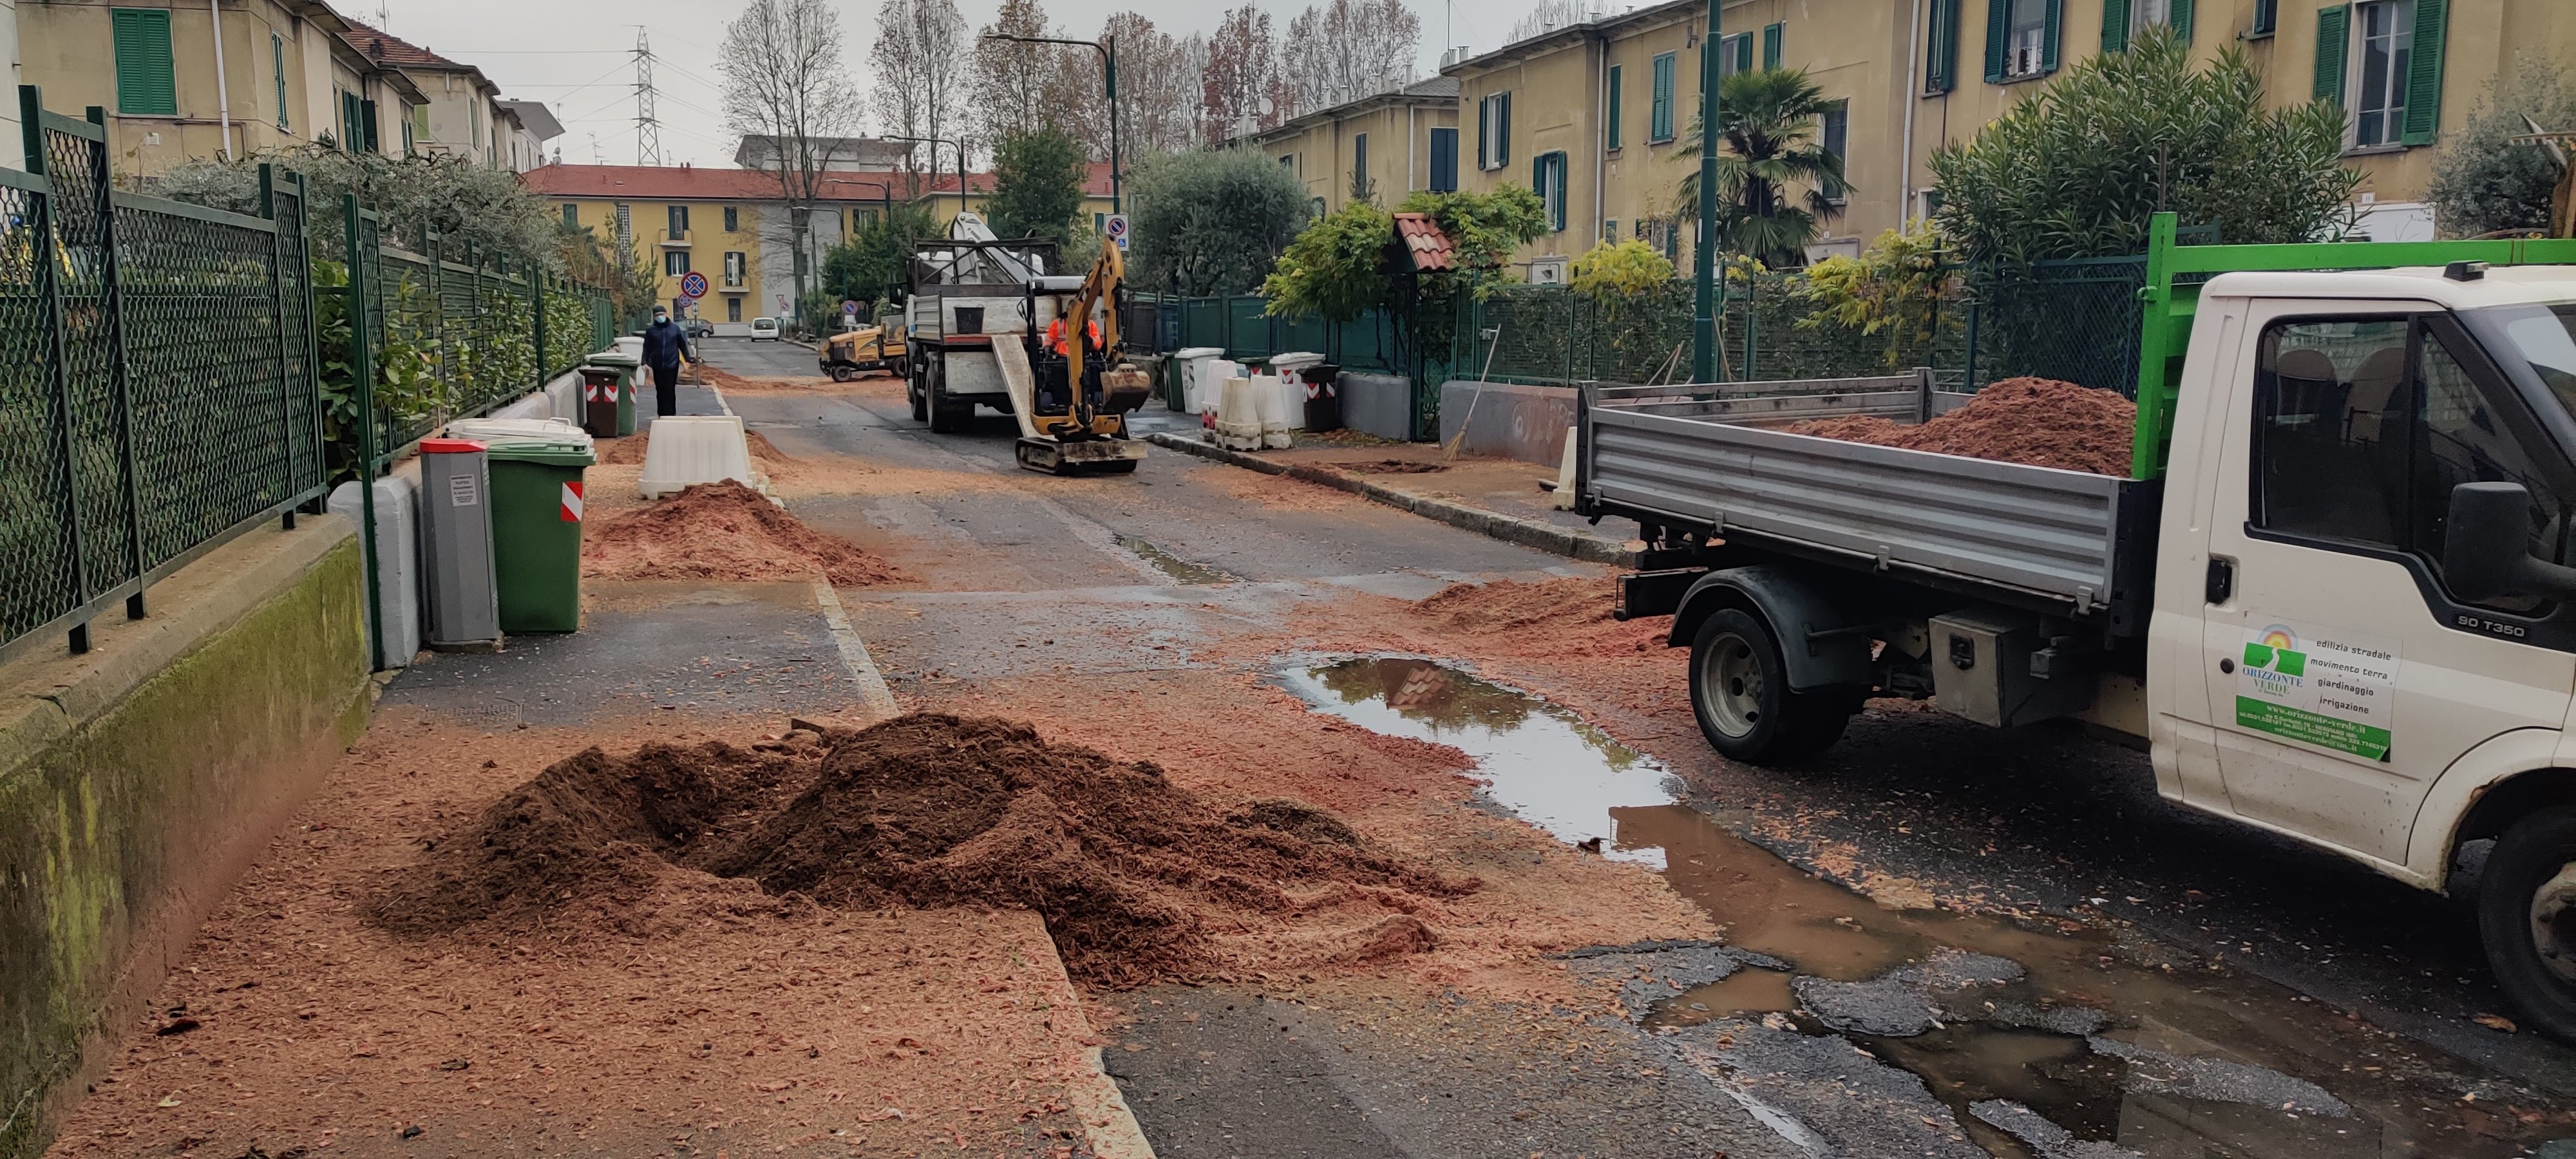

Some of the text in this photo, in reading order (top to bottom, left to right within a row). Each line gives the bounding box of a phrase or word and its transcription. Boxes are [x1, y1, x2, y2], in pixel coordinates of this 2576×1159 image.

[2458, 616, 2525, 637] 90 T350
[2316, 640, 2391, 660] edilizia stradale
[2242, 666, 2304, 688] ORIZZONTE
[2311, 659, 2388, 679] movimento terra
[2254, 678, 2290, 694] VERDE
[2318, 677, 2374, 695] giardinaggio
[2320, 695, 2369, 714] irrigazione
[2266, 705, 2366, 733] www.orizzonte-verde.it
